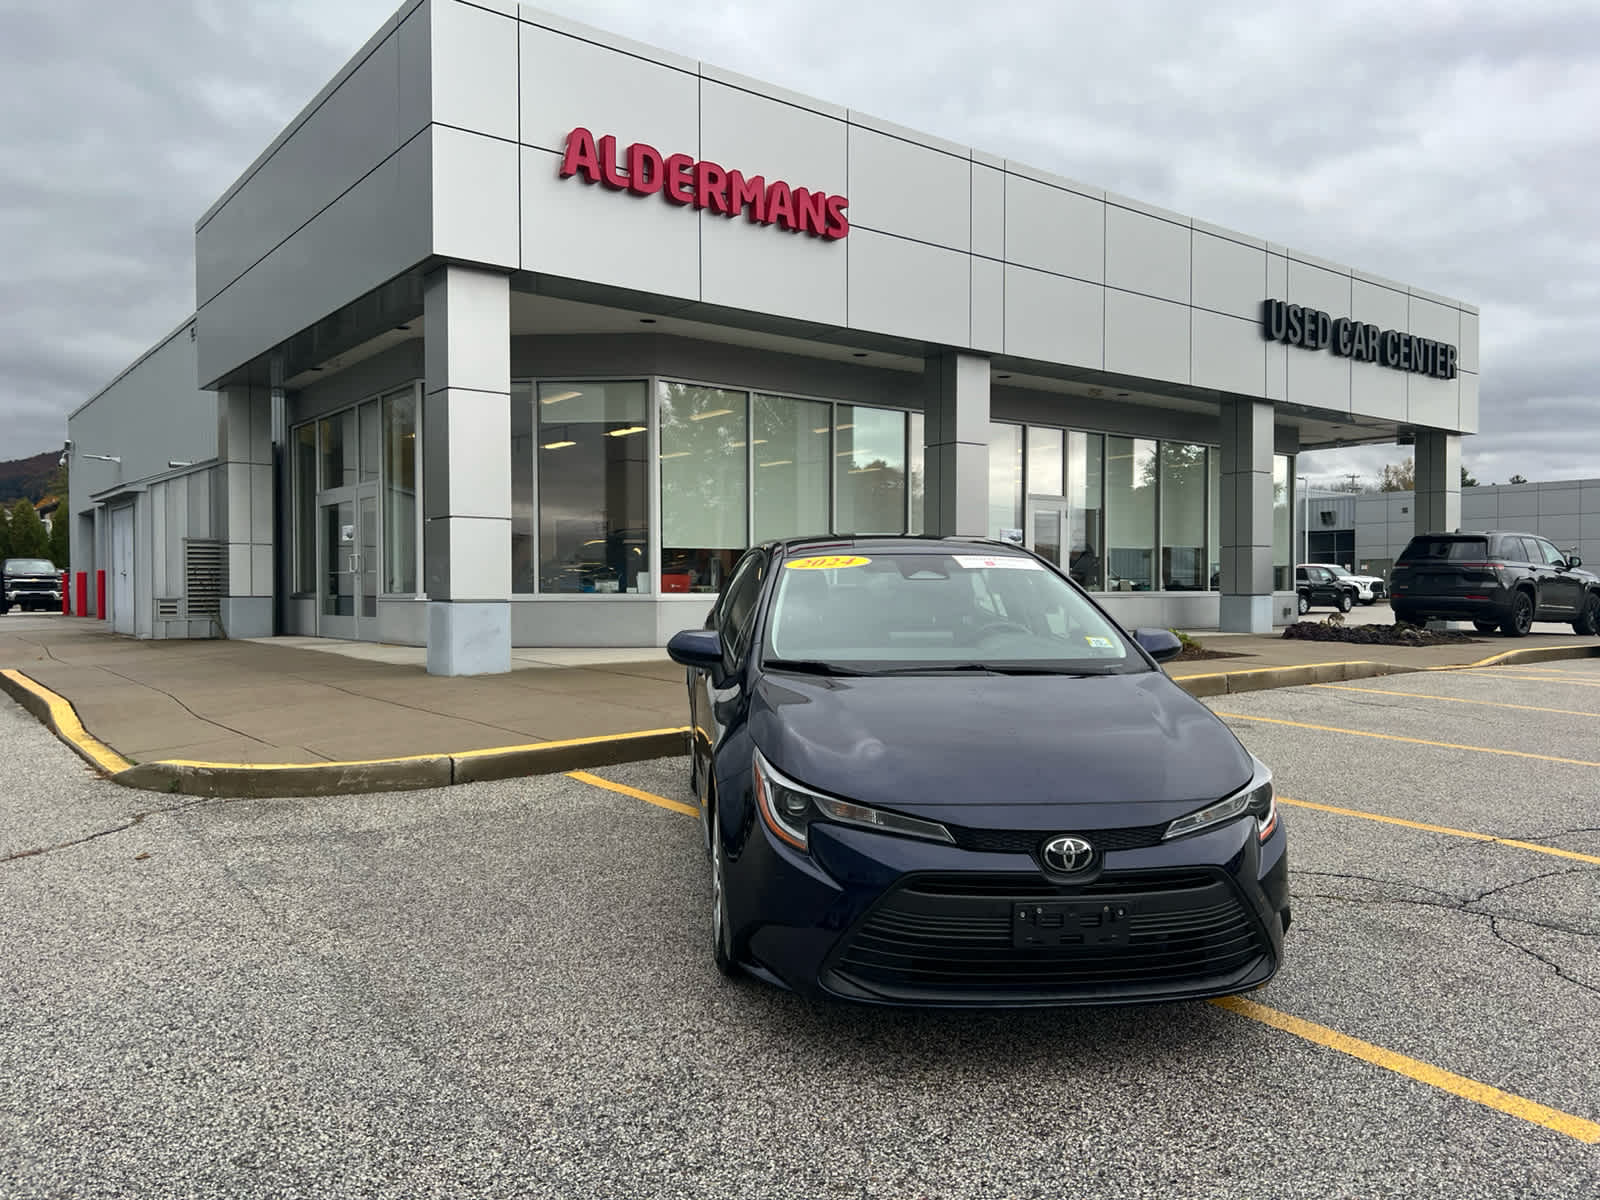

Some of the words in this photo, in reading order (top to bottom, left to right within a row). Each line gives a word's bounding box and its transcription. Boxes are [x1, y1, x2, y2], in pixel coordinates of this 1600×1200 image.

[559, 127, 850, 241] ALDERMANS
[1264, 299, 1332, 350] USED
[1334, 317, 1380, 362] CAR
[1382, 329, 1458, 379] CENTER
[797, 557, 856, 569] 2024
